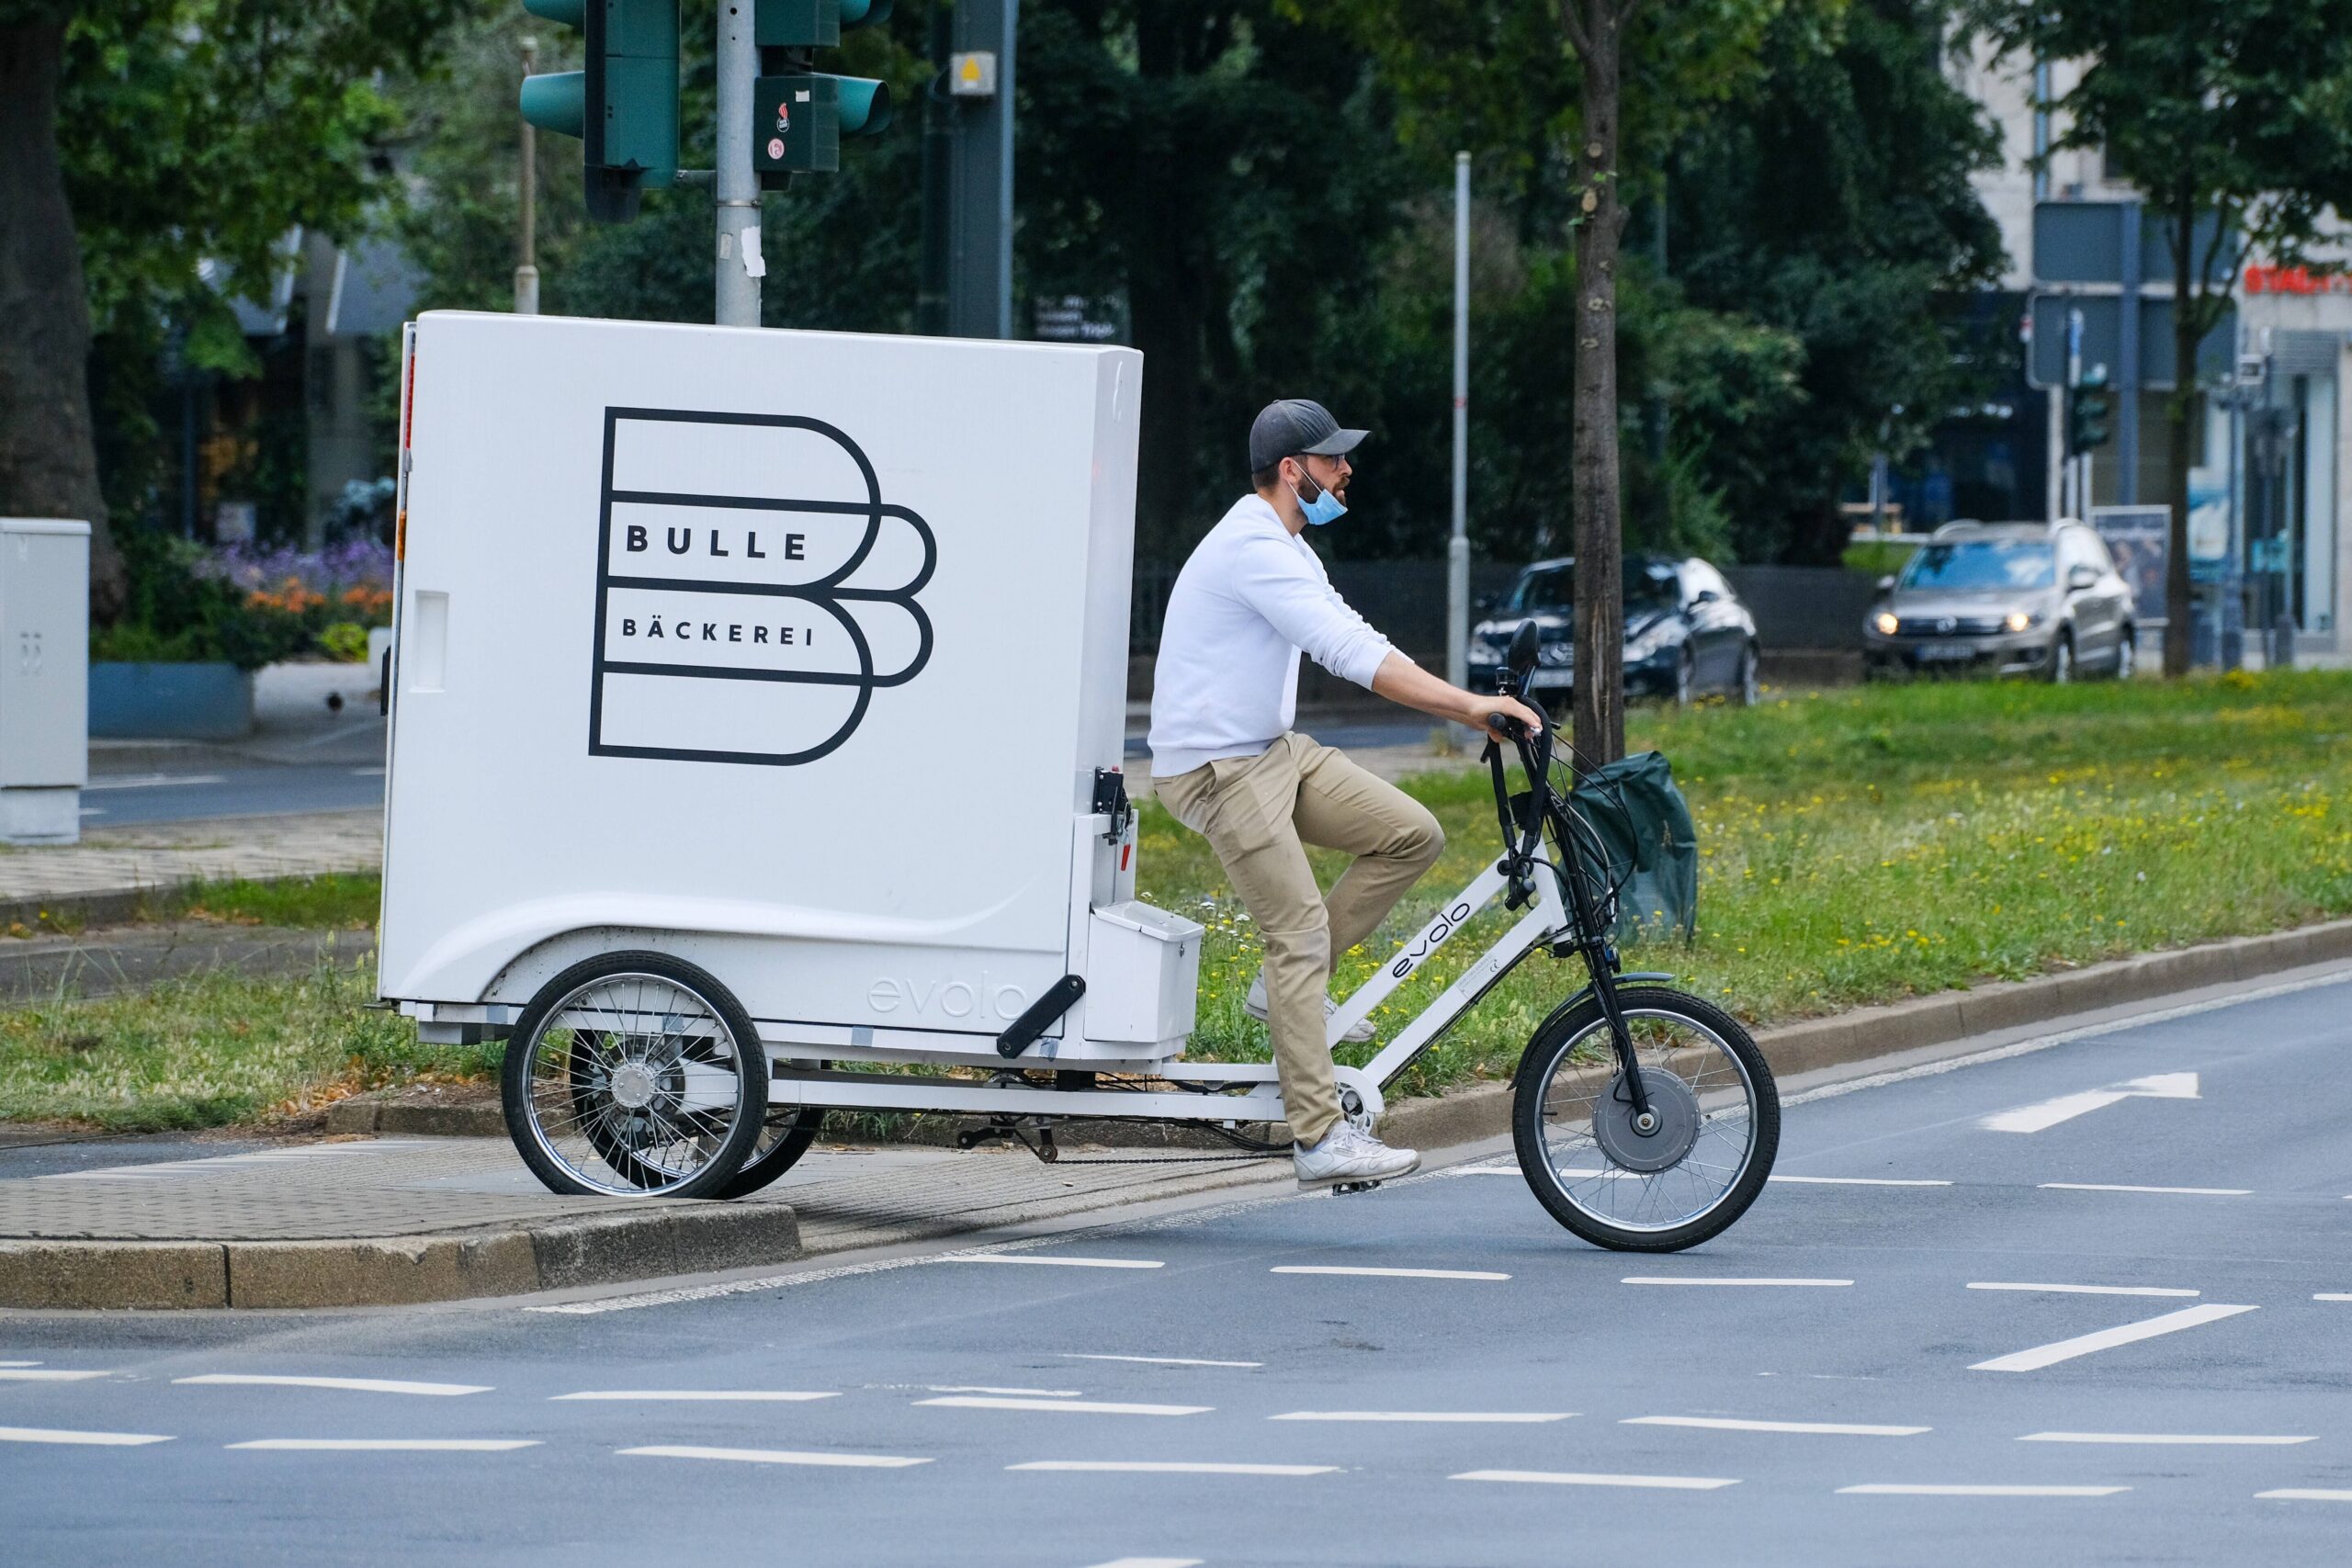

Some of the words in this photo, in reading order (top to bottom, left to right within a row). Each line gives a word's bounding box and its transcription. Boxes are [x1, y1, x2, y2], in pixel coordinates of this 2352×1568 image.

[627, 525, 805, 561] BULLE
[622, 614, 812, 647] BÄCKEREI
[1393, 903, 1470, 977] evolo
[867, 970, 1028, 1021] evolo
